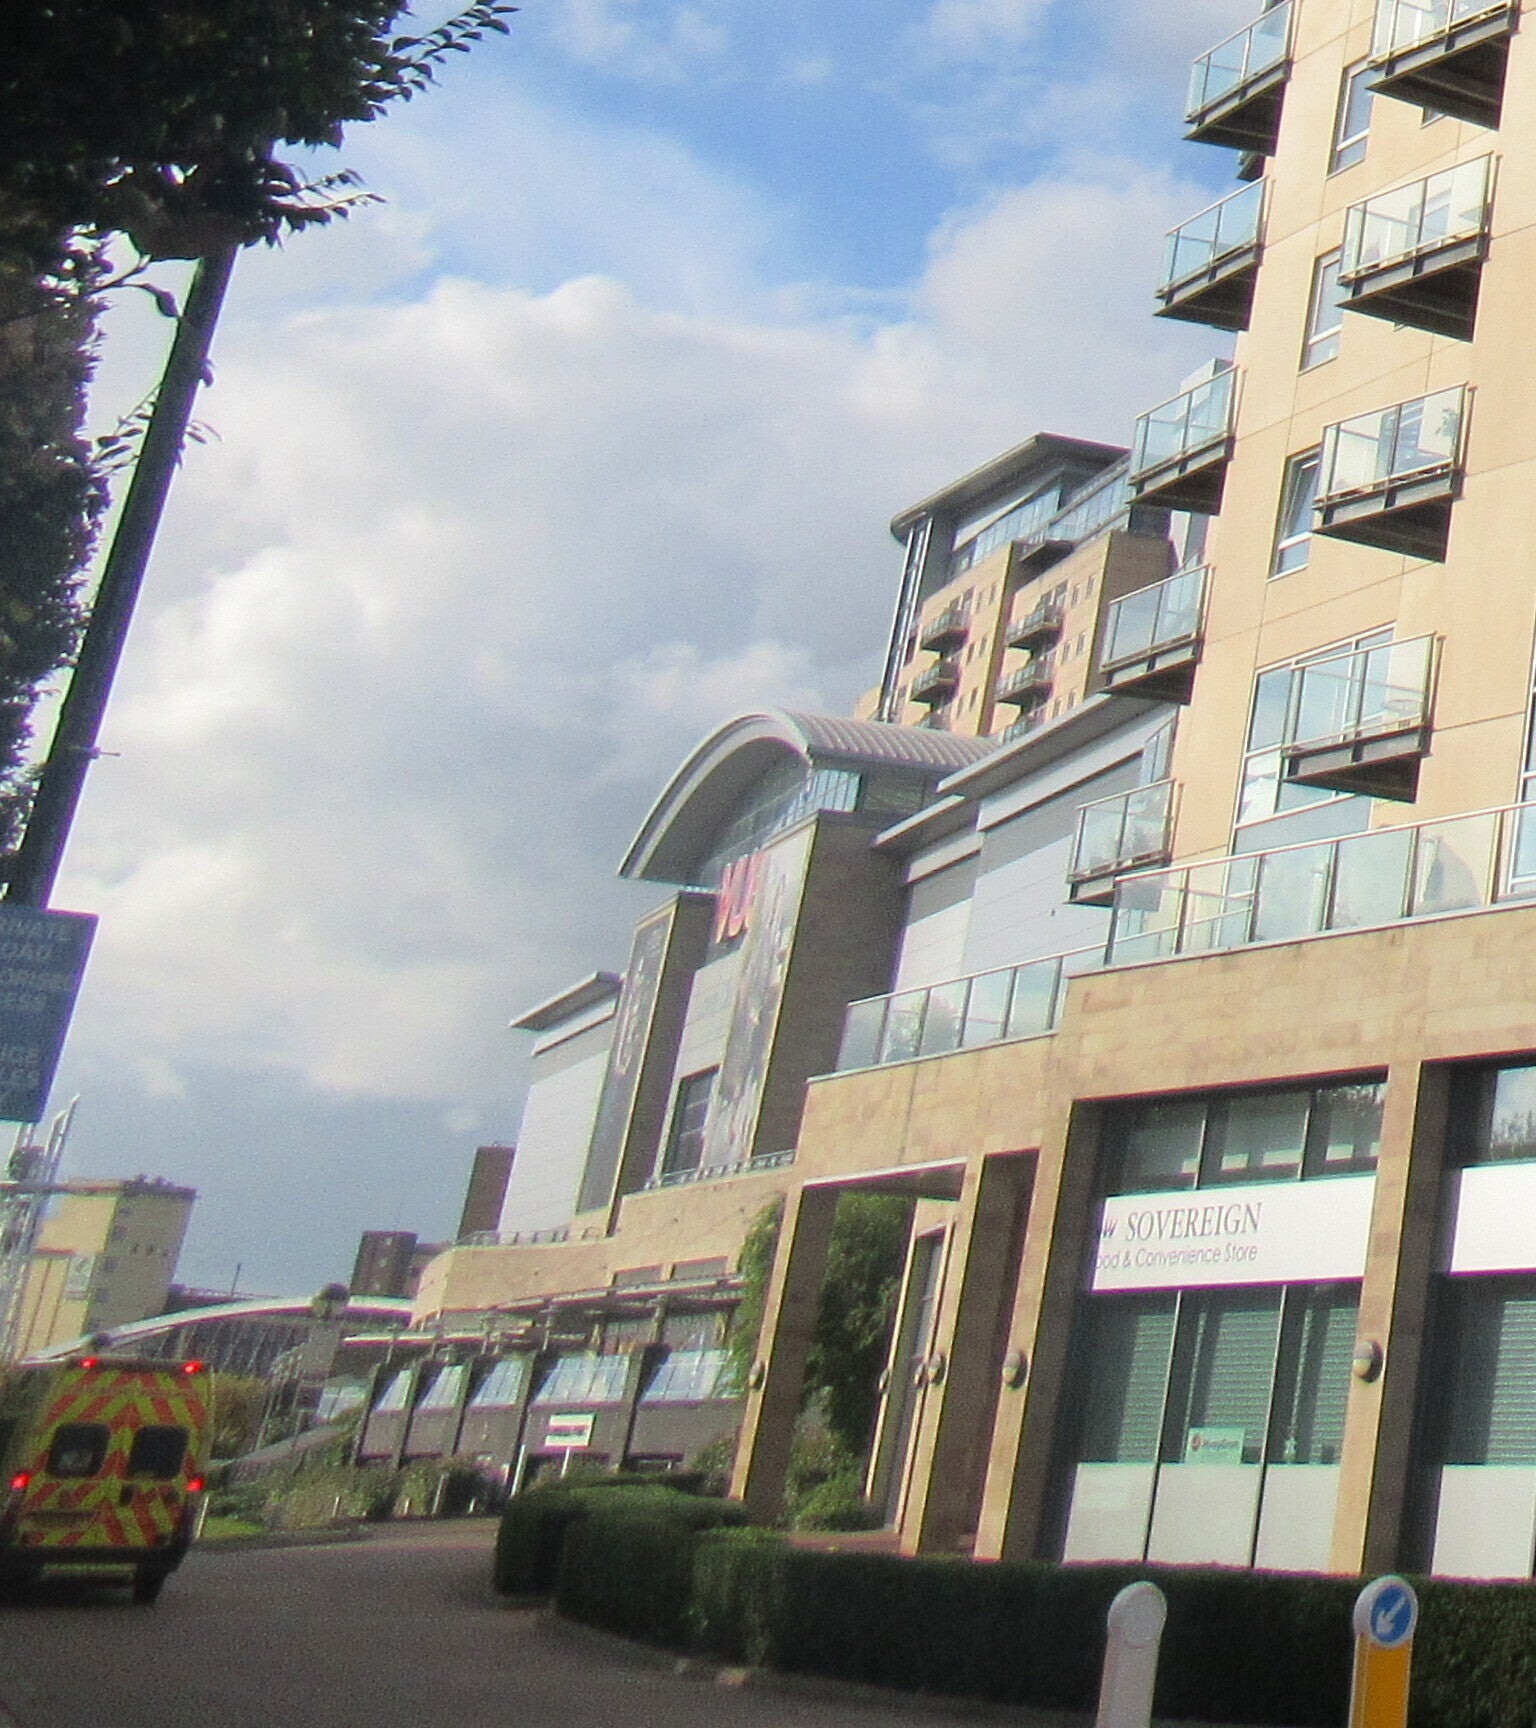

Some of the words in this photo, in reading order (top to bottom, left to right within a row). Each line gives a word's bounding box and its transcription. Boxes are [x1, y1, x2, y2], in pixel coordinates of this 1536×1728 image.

[0, 941, 53, 963] OAD
[1125, 1202, 1263, 1242] SOVEREIGN
[1123, 1250, 1132, 1269] &
[1135, 1245, 1222, 1268] Convenience
[1224, 1242, 1258, 1264] Store
